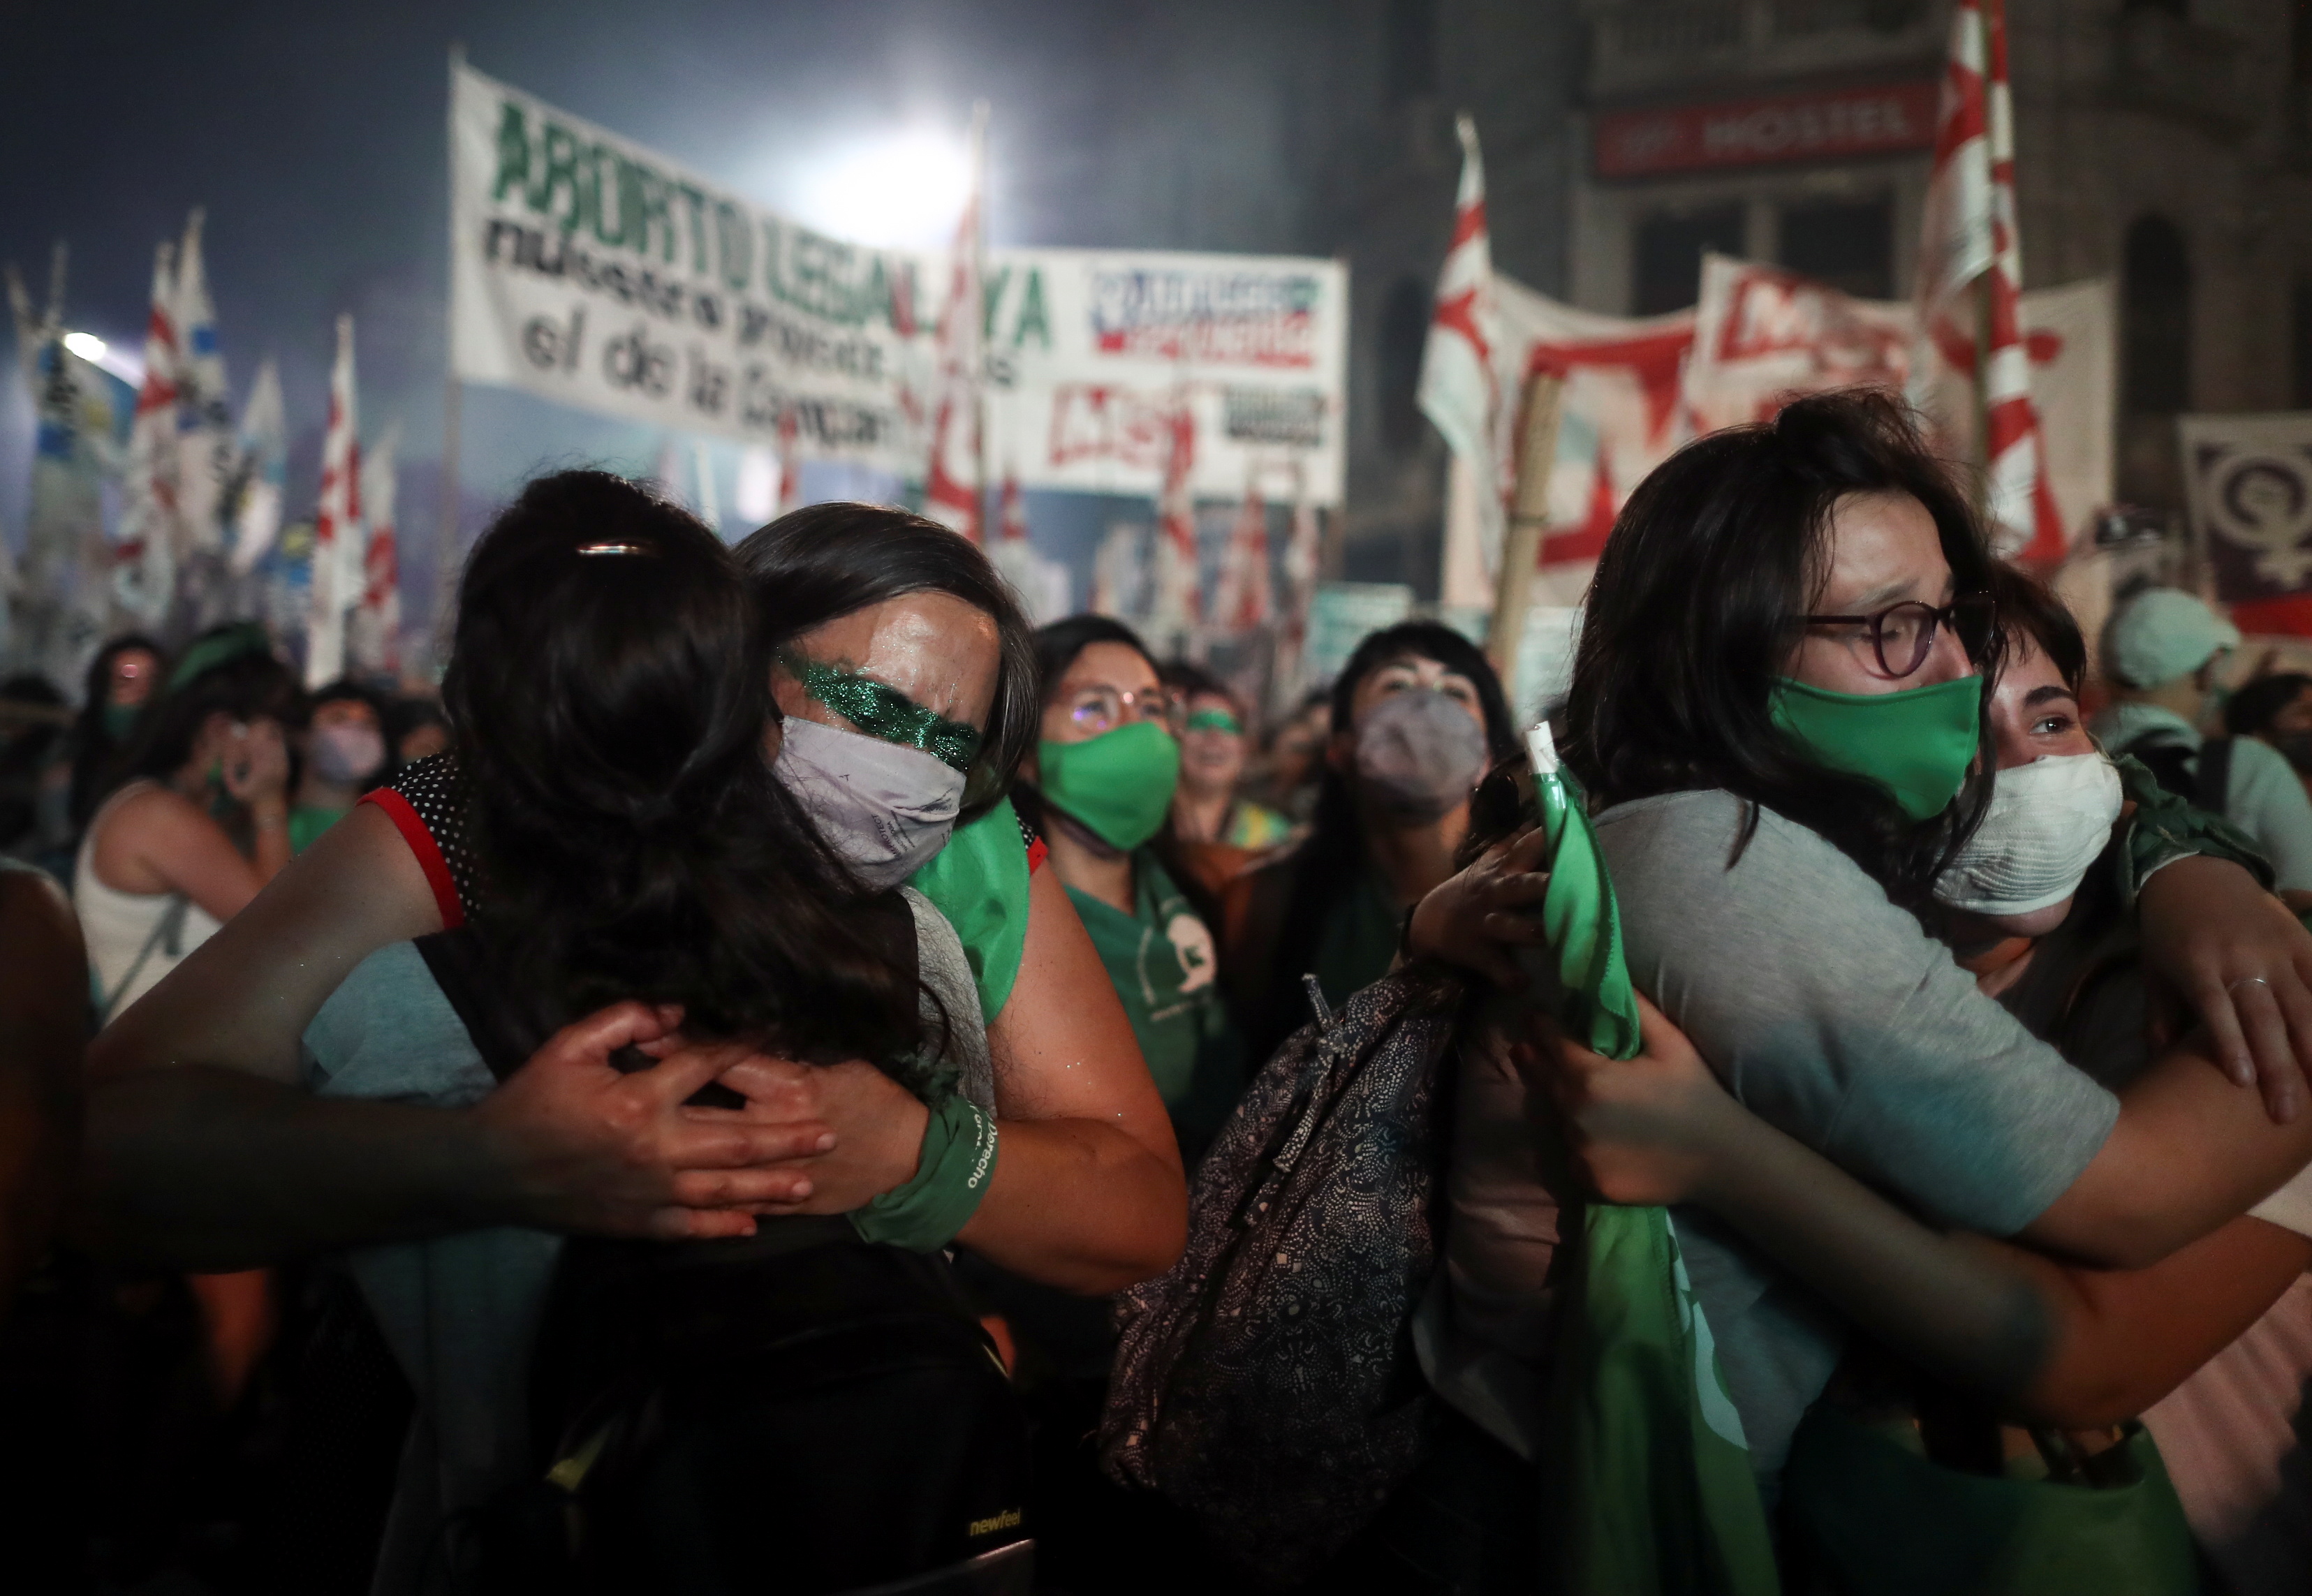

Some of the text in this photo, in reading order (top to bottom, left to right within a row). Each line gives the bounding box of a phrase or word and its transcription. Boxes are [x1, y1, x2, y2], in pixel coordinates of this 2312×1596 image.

[1702, 100, 1910, 155] HOSTEL
[492, 98, 754, 289] ABORTO
[522, 303, 587, 373] el
[601, 324, 676, 401] de
[968, 1121, 999, 1188] Derecho
[969, 1507, 1021, 1537] newfeel
